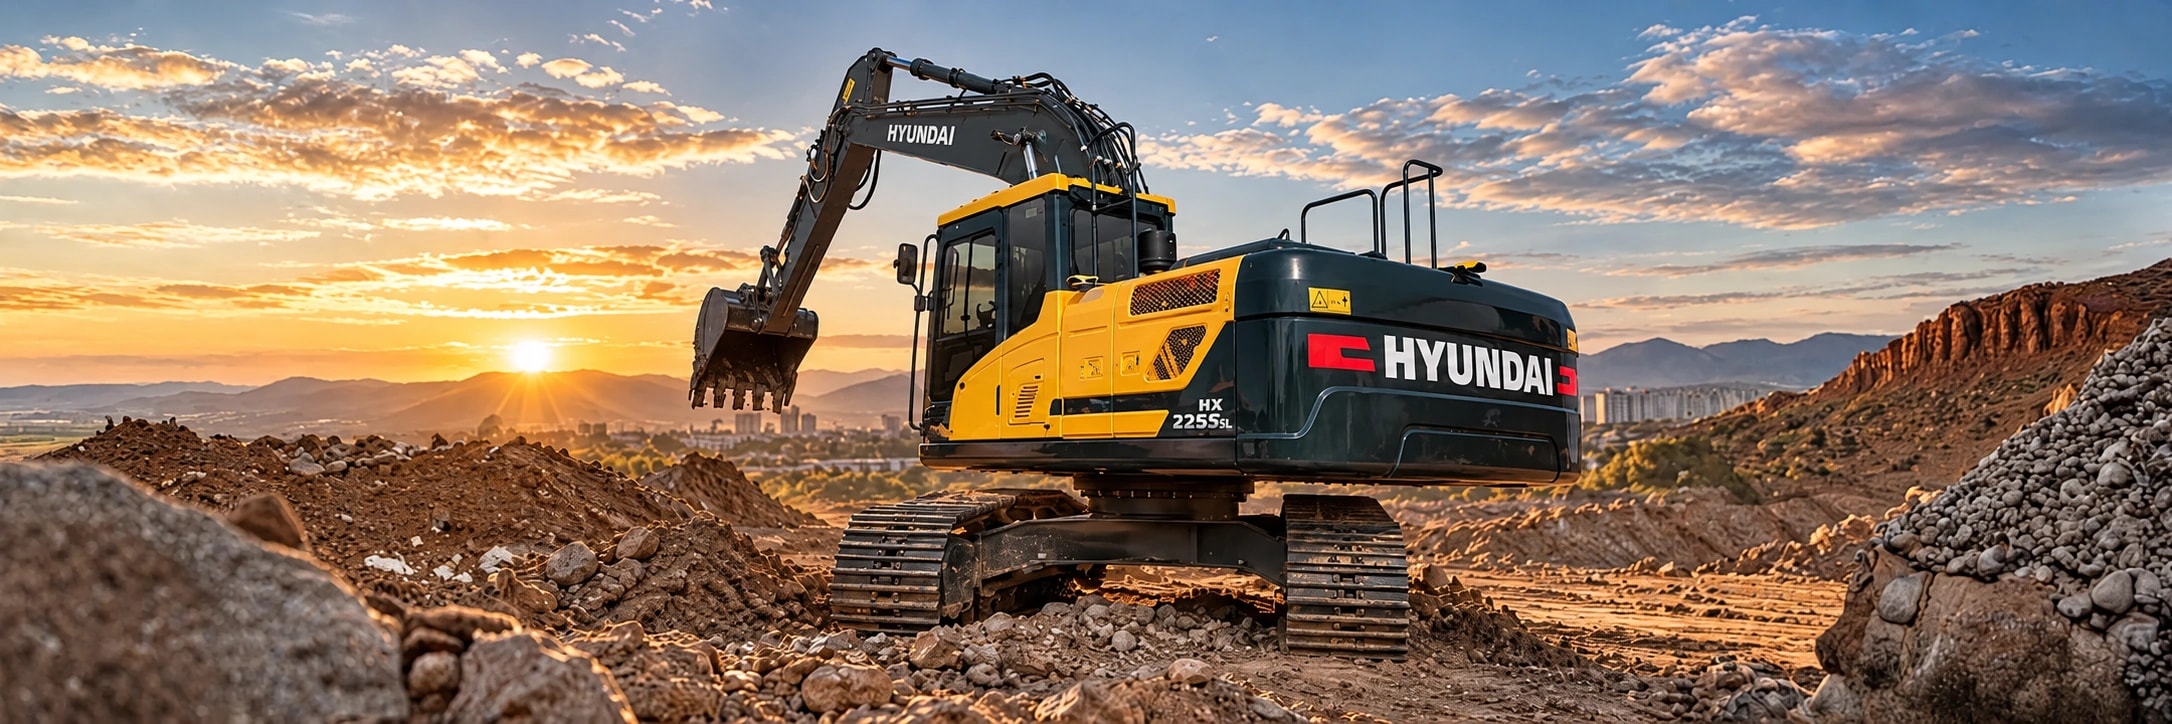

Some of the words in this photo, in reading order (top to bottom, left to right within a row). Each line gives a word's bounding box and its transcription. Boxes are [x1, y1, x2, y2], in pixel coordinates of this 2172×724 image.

[887, 124, 955, 146] HYUNDAI
[1384, 335, 1554, 396] HYUNDAI
[1199, 399, 1223, 411] HX
